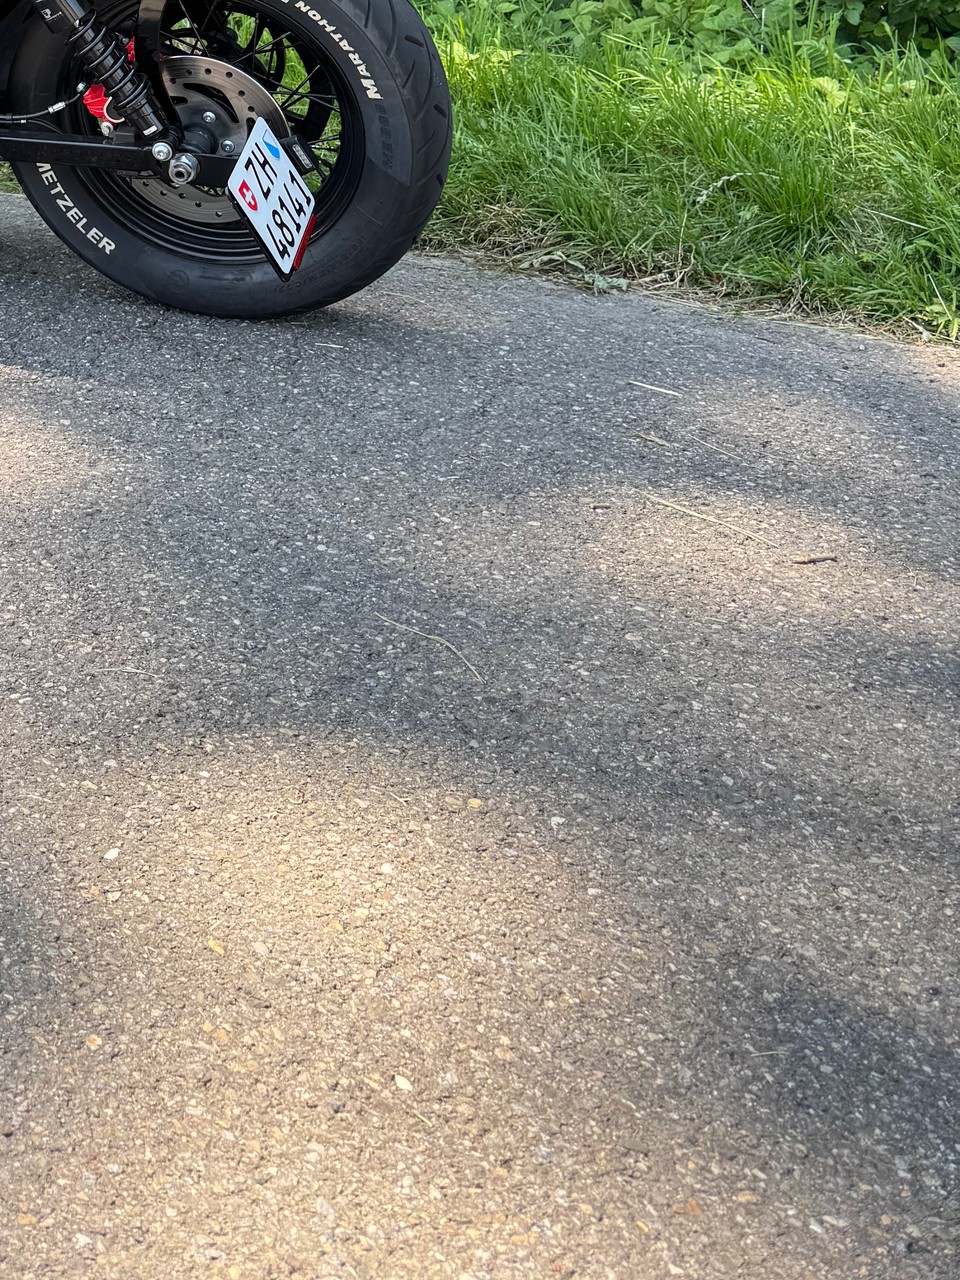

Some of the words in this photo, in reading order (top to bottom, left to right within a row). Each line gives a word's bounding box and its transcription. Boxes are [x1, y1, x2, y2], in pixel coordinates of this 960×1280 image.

[294, 0, 383, 100] MARATHON
[244, 142, 278, 201] ZH
[266, 169, 312, 260] 48141
